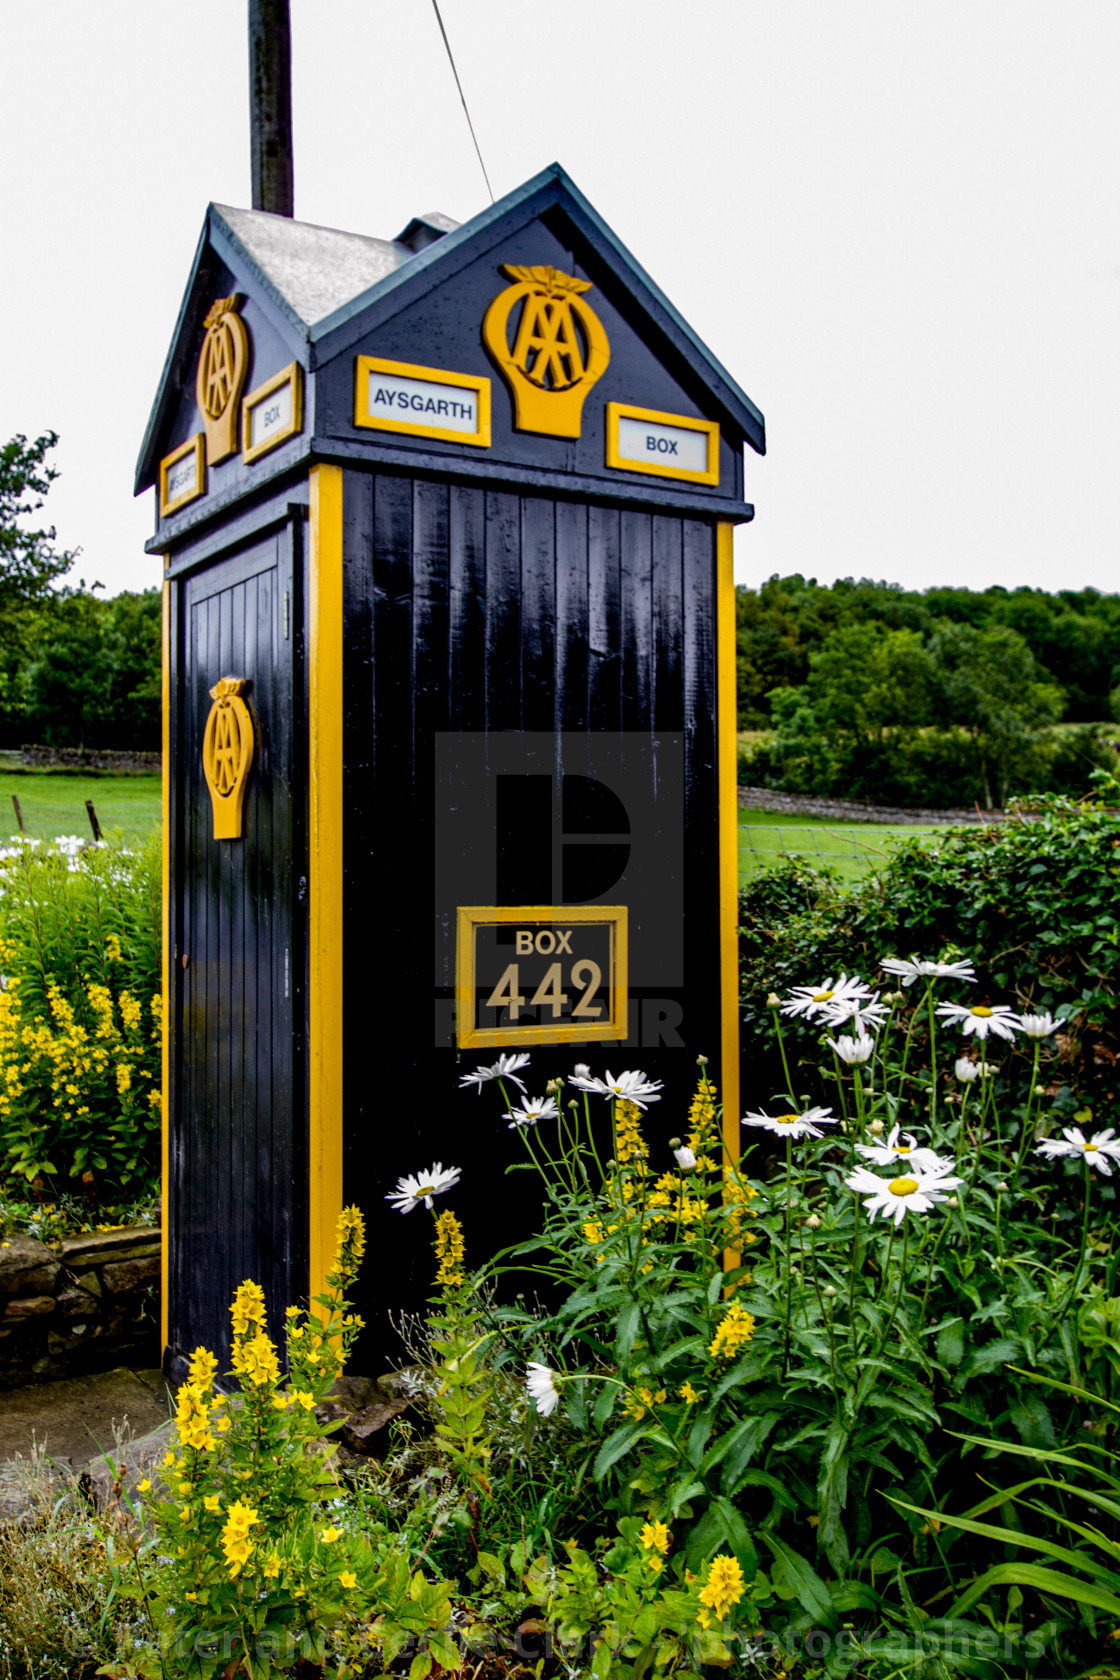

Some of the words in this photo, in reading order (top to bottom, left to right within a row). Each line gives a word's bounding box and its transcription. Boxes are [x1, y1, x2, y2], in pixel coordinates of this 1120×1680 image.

[264, 404, 281, 428] BOX
[374, 388, 472, 420] AYSGARTH
[646, 436, 678, 456] BOX
[515, 930, 574, 955] BOX
[485, 958, 603, 1020] 442
